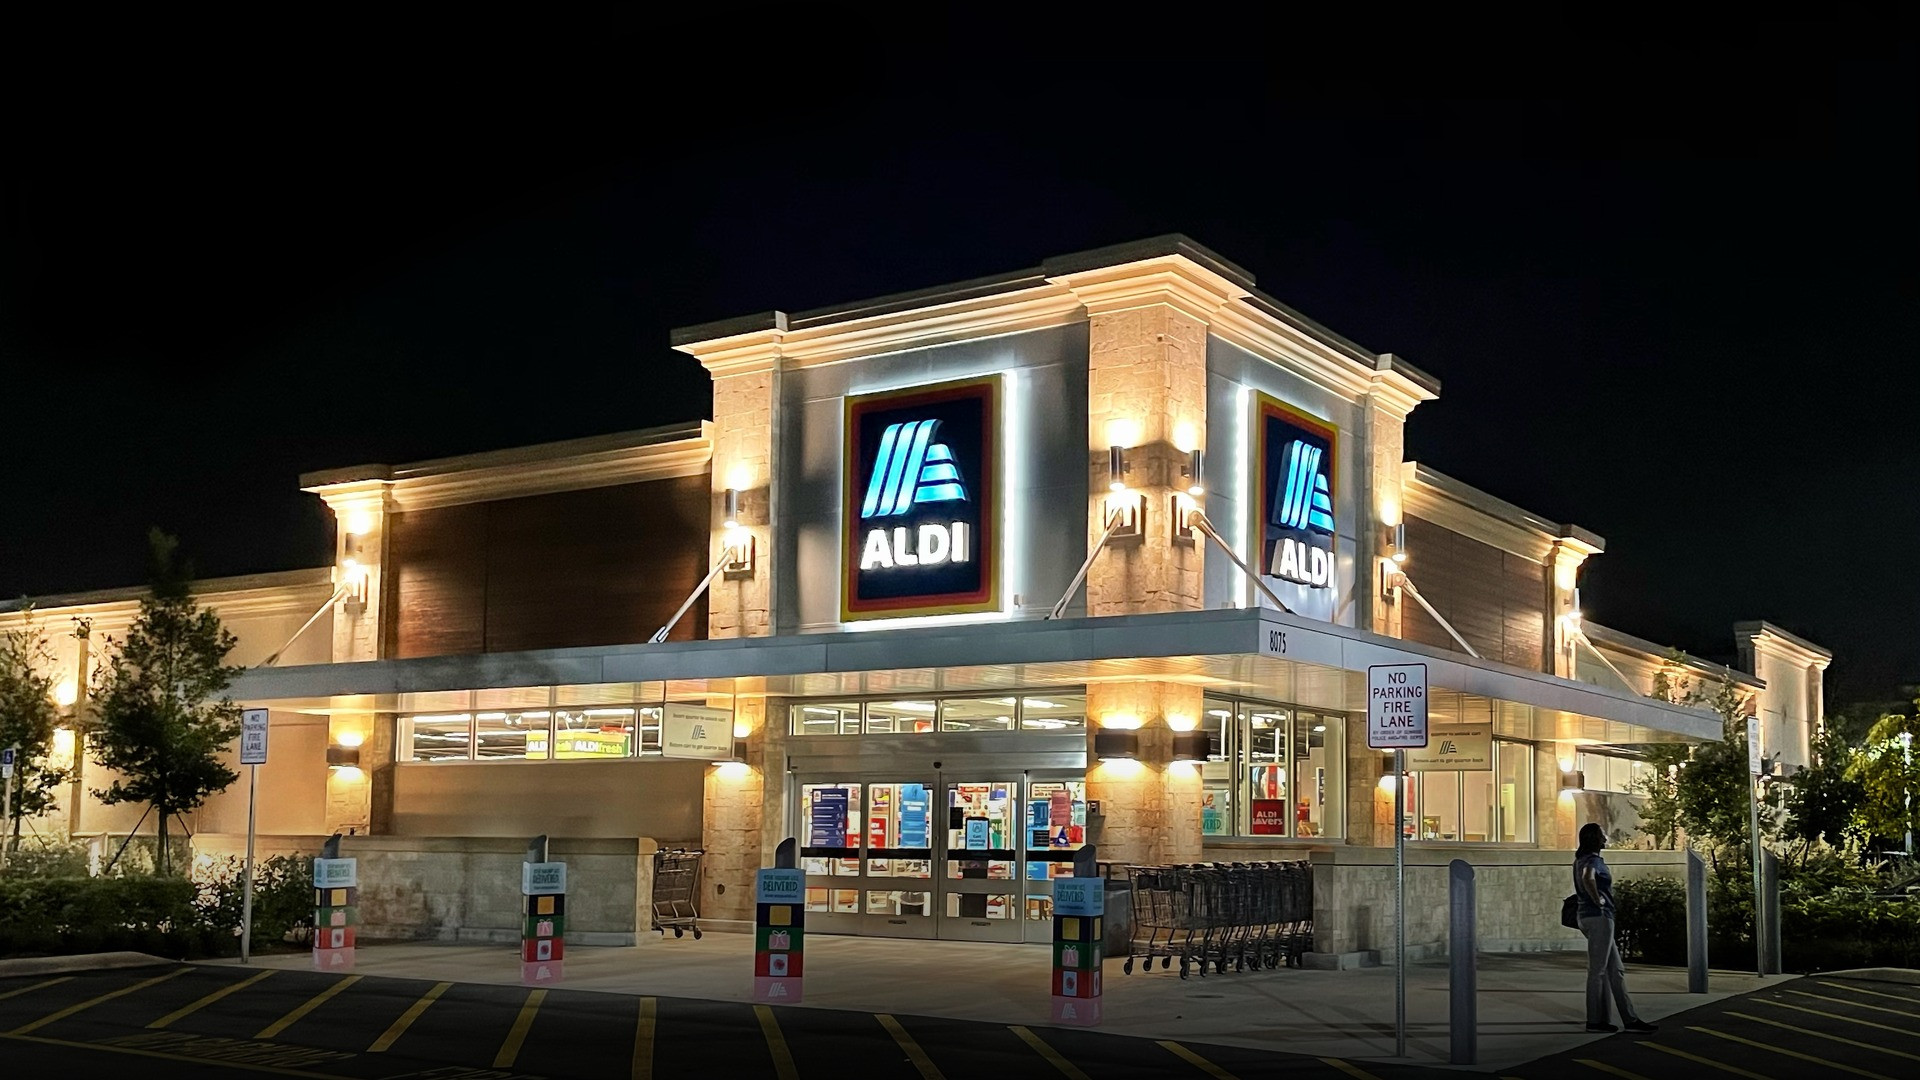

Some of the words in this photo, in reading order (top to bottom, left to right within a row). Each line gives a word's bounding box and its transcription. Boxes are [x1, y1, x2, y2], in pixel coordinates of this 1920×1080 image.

[860, 522, 969, 569] ALDI
[1277, 538, 1334, 587] ALDI
[1270, 630, 1286, 653] 8075
[1388, 673, 1406, 684] NO
[1373, 686, 1422, 698] PARKING
[1384, 701, 1411, 713] FIRE
[251, 714, 260, 722] NO
[1381, 716, 1414, 727] LANE
[246, 742, 261, 751] LANE
